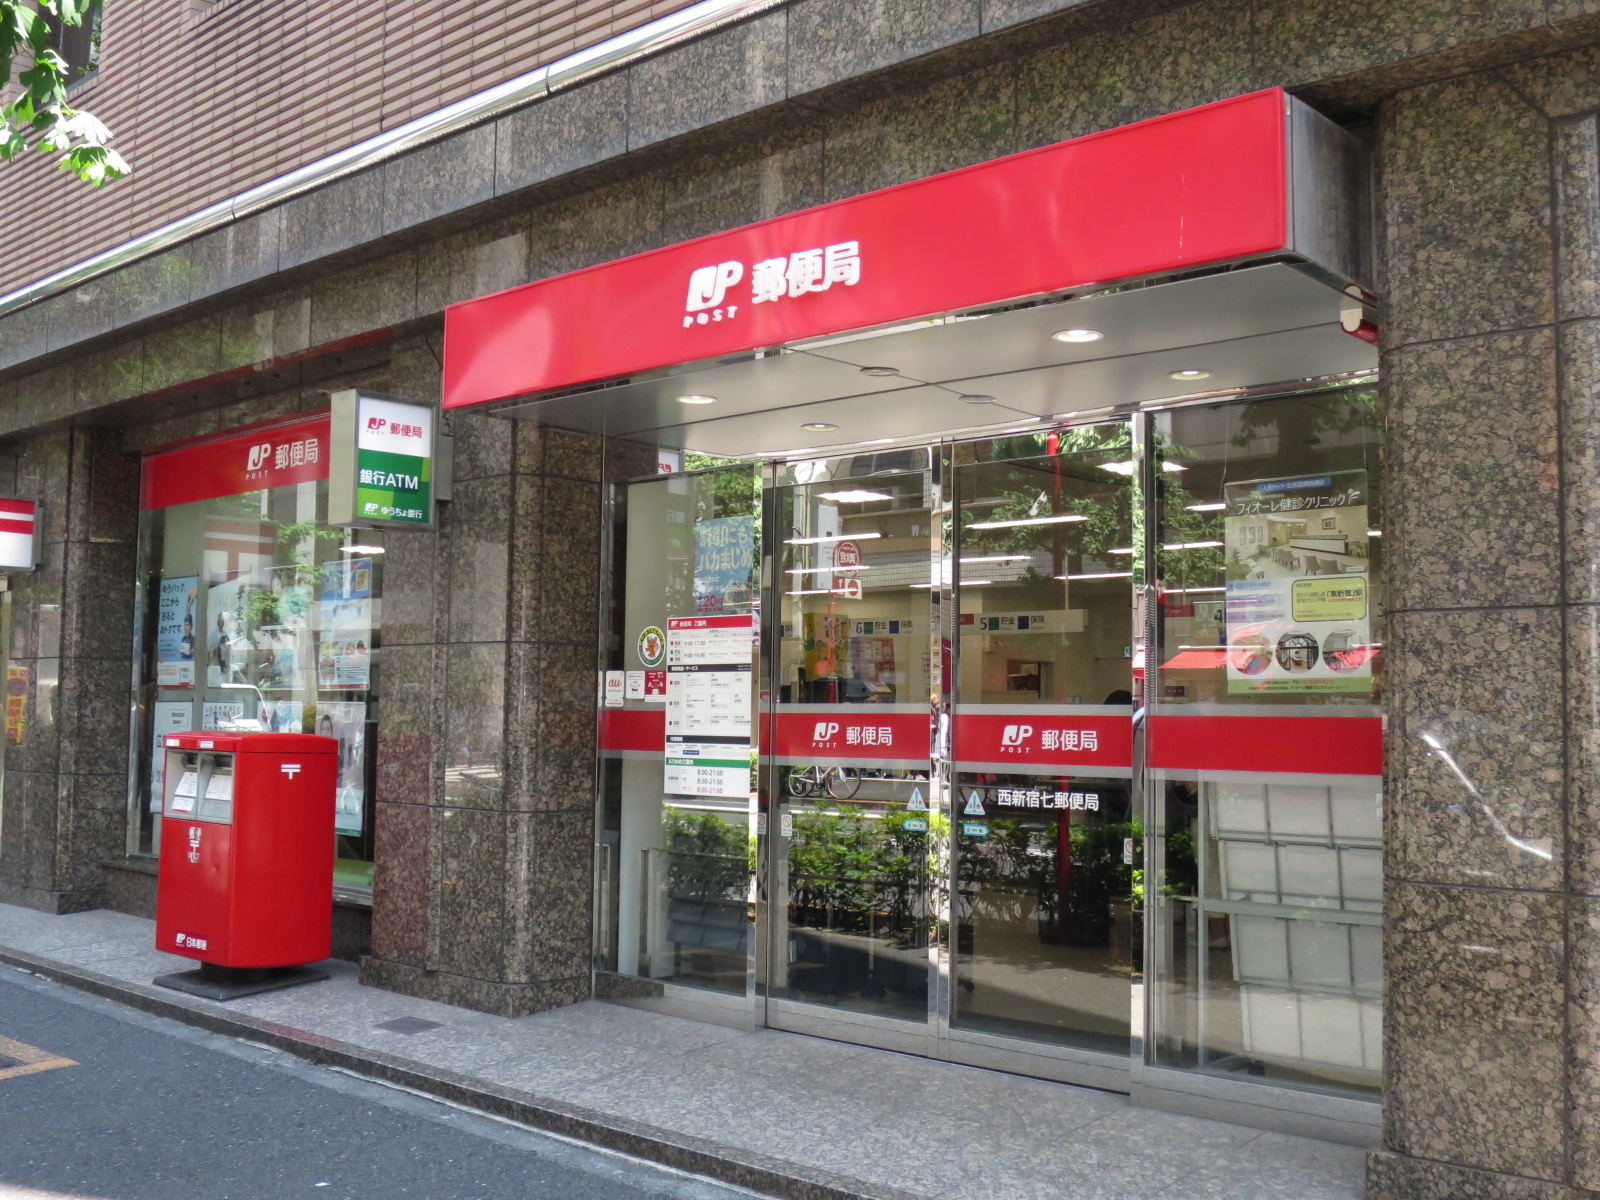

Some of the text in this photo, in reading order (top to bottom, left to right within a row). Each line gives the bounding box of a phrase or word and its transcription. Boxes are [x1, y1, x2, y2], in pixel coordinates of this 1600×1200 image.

[685, 241, 860, 312] JP 郵便局
[683, 306, 738, 328] POST
[367, 417, 422, 438] JP 郵便局
[247, 438, 318, 471] JP 郵便局
[245, 469, 268, 480] POST
[360, 468, 418, 490] 銀行ATM
[381, 506, 422, 518] ゆうちょ銀行
[1237, 494, 1346, 515] フィオーレ健診クリニック
[700, 548, 753, 572] バカまじめ
[980, 615, 1045, 630] 5 貯金 保険
[1214, 609, 1223, 622] 4
[856, 621, 913, 634] 6 貯金 保険
[608, 679, 622, 688] au
[813, 722, 893, 746] JP 郵便局
[1002, 725, 1098, 751] JP 郵便局
[997, 789, 1099, 811] 西新宿七郵便局
[186, 937, 208, 950] 日本郵便
